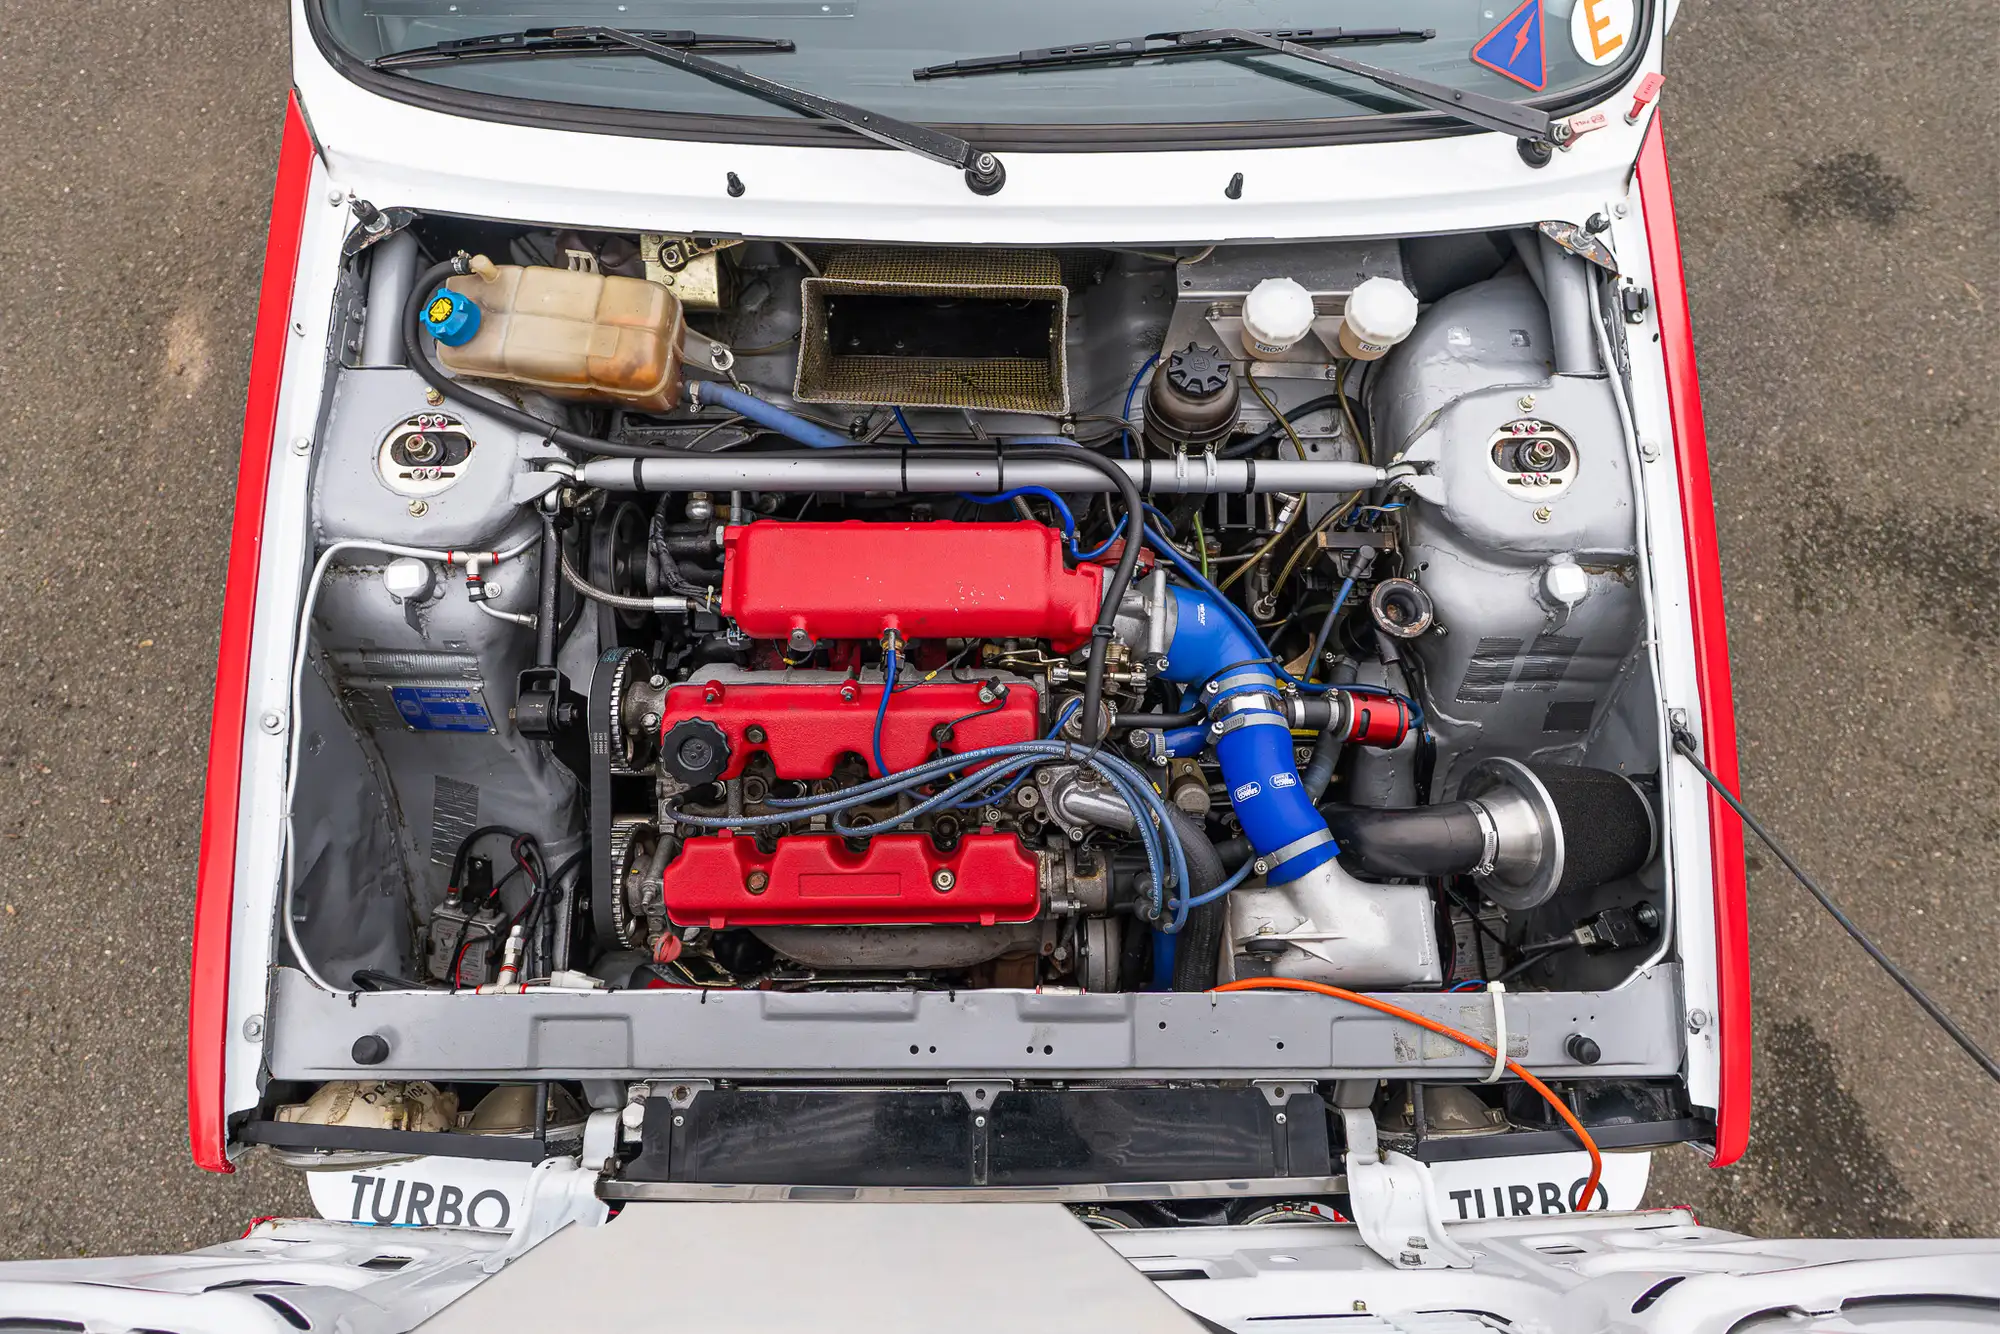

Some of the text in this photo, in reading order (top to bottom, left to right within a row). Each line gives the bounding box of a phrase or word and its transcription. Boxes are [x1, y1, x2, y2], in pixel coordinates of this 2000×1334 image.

[1583, 0, 1624, 60] E
[351, 1175, 511, 1229] TURBO
[1449, 1177, 1609, 1220] TURBO
